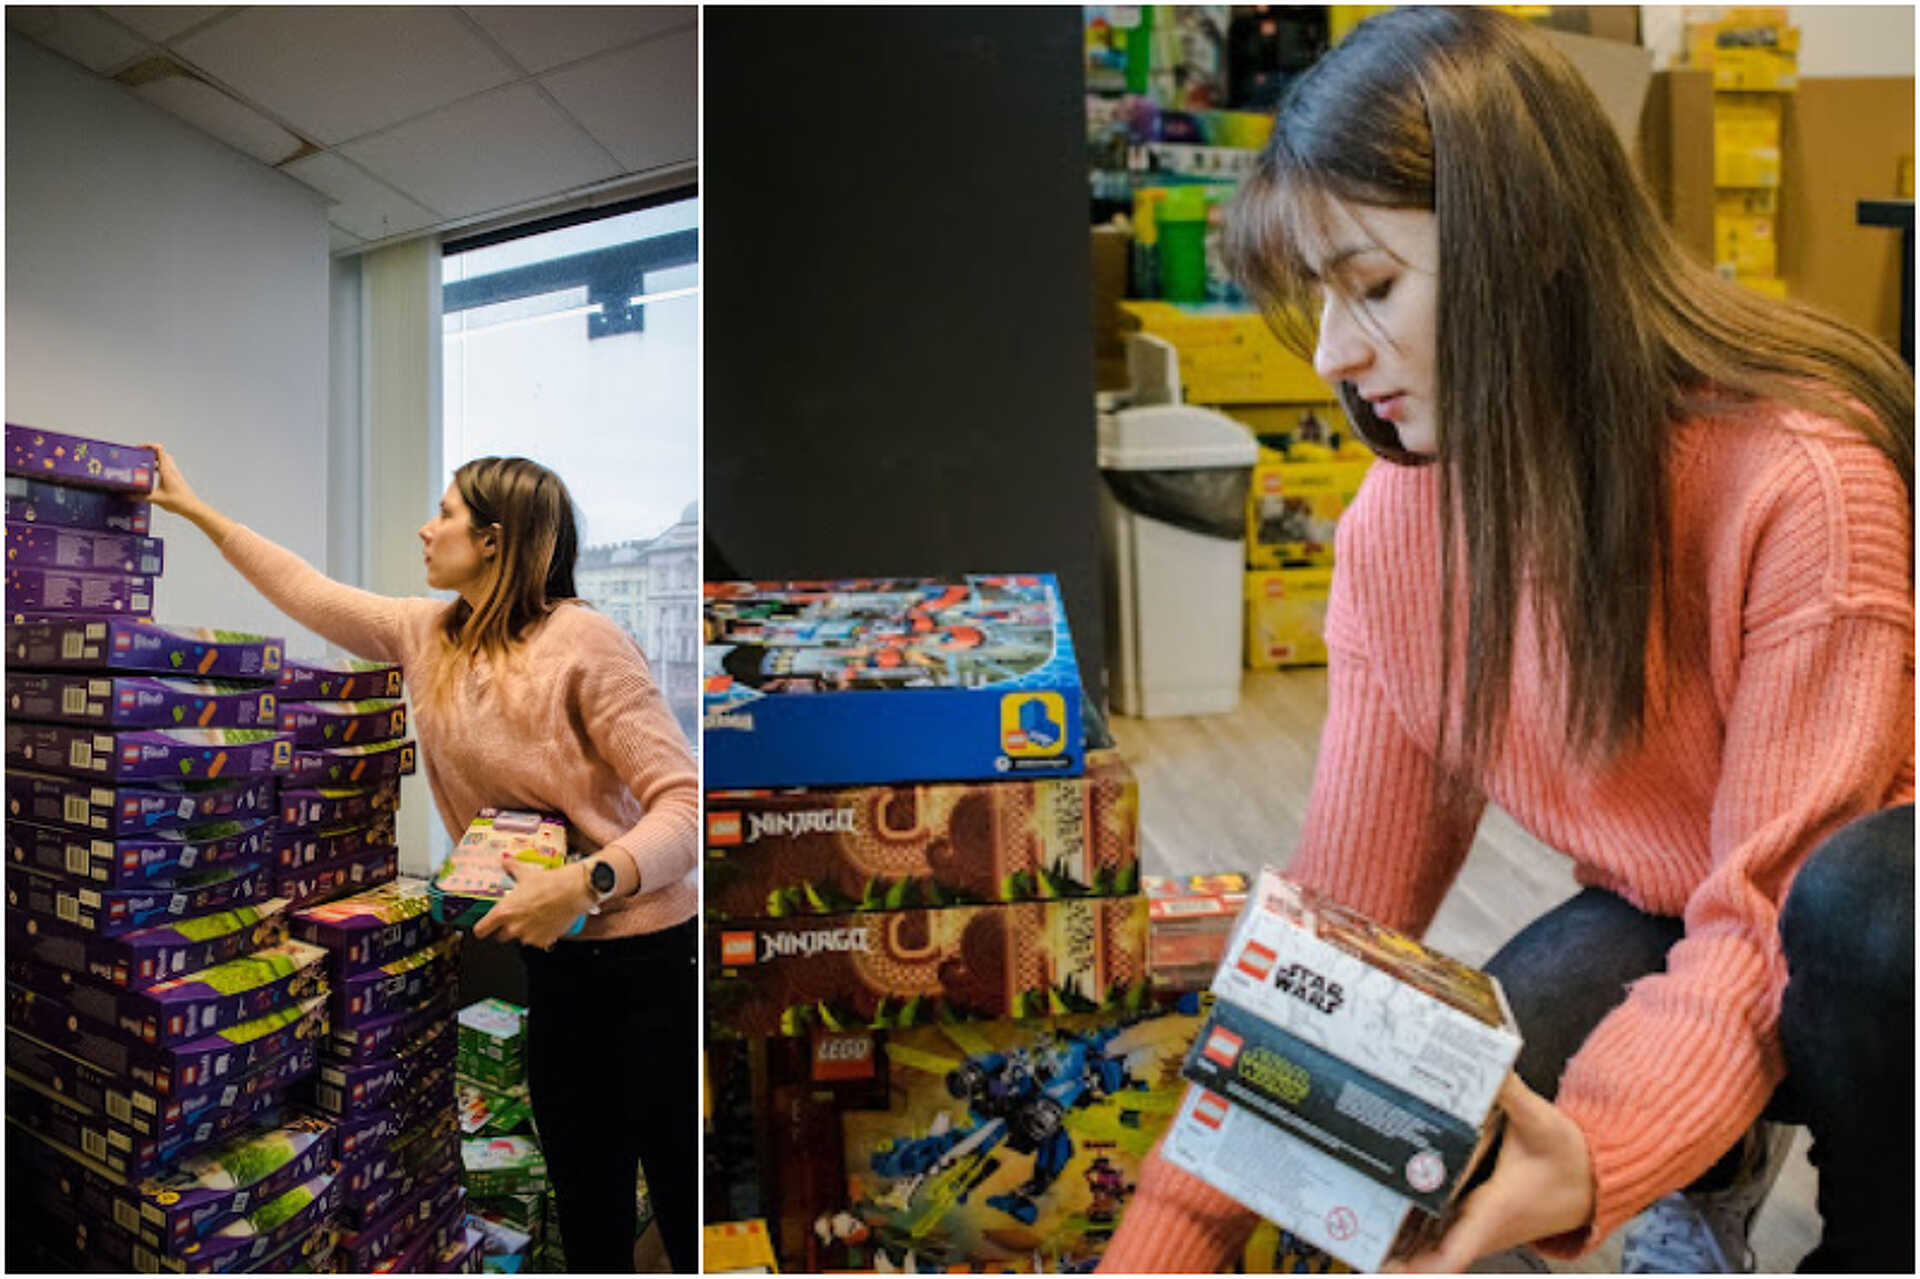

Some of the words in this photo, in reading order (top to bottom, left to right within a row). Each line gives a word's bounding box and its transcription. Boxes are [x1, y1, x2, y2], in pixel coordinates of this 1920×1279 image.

[746, 808, 859, 843] NINJAGO
[759, 928, 872, 963] NINJAGO
[818, 1037, 872, 1060] LEGO
